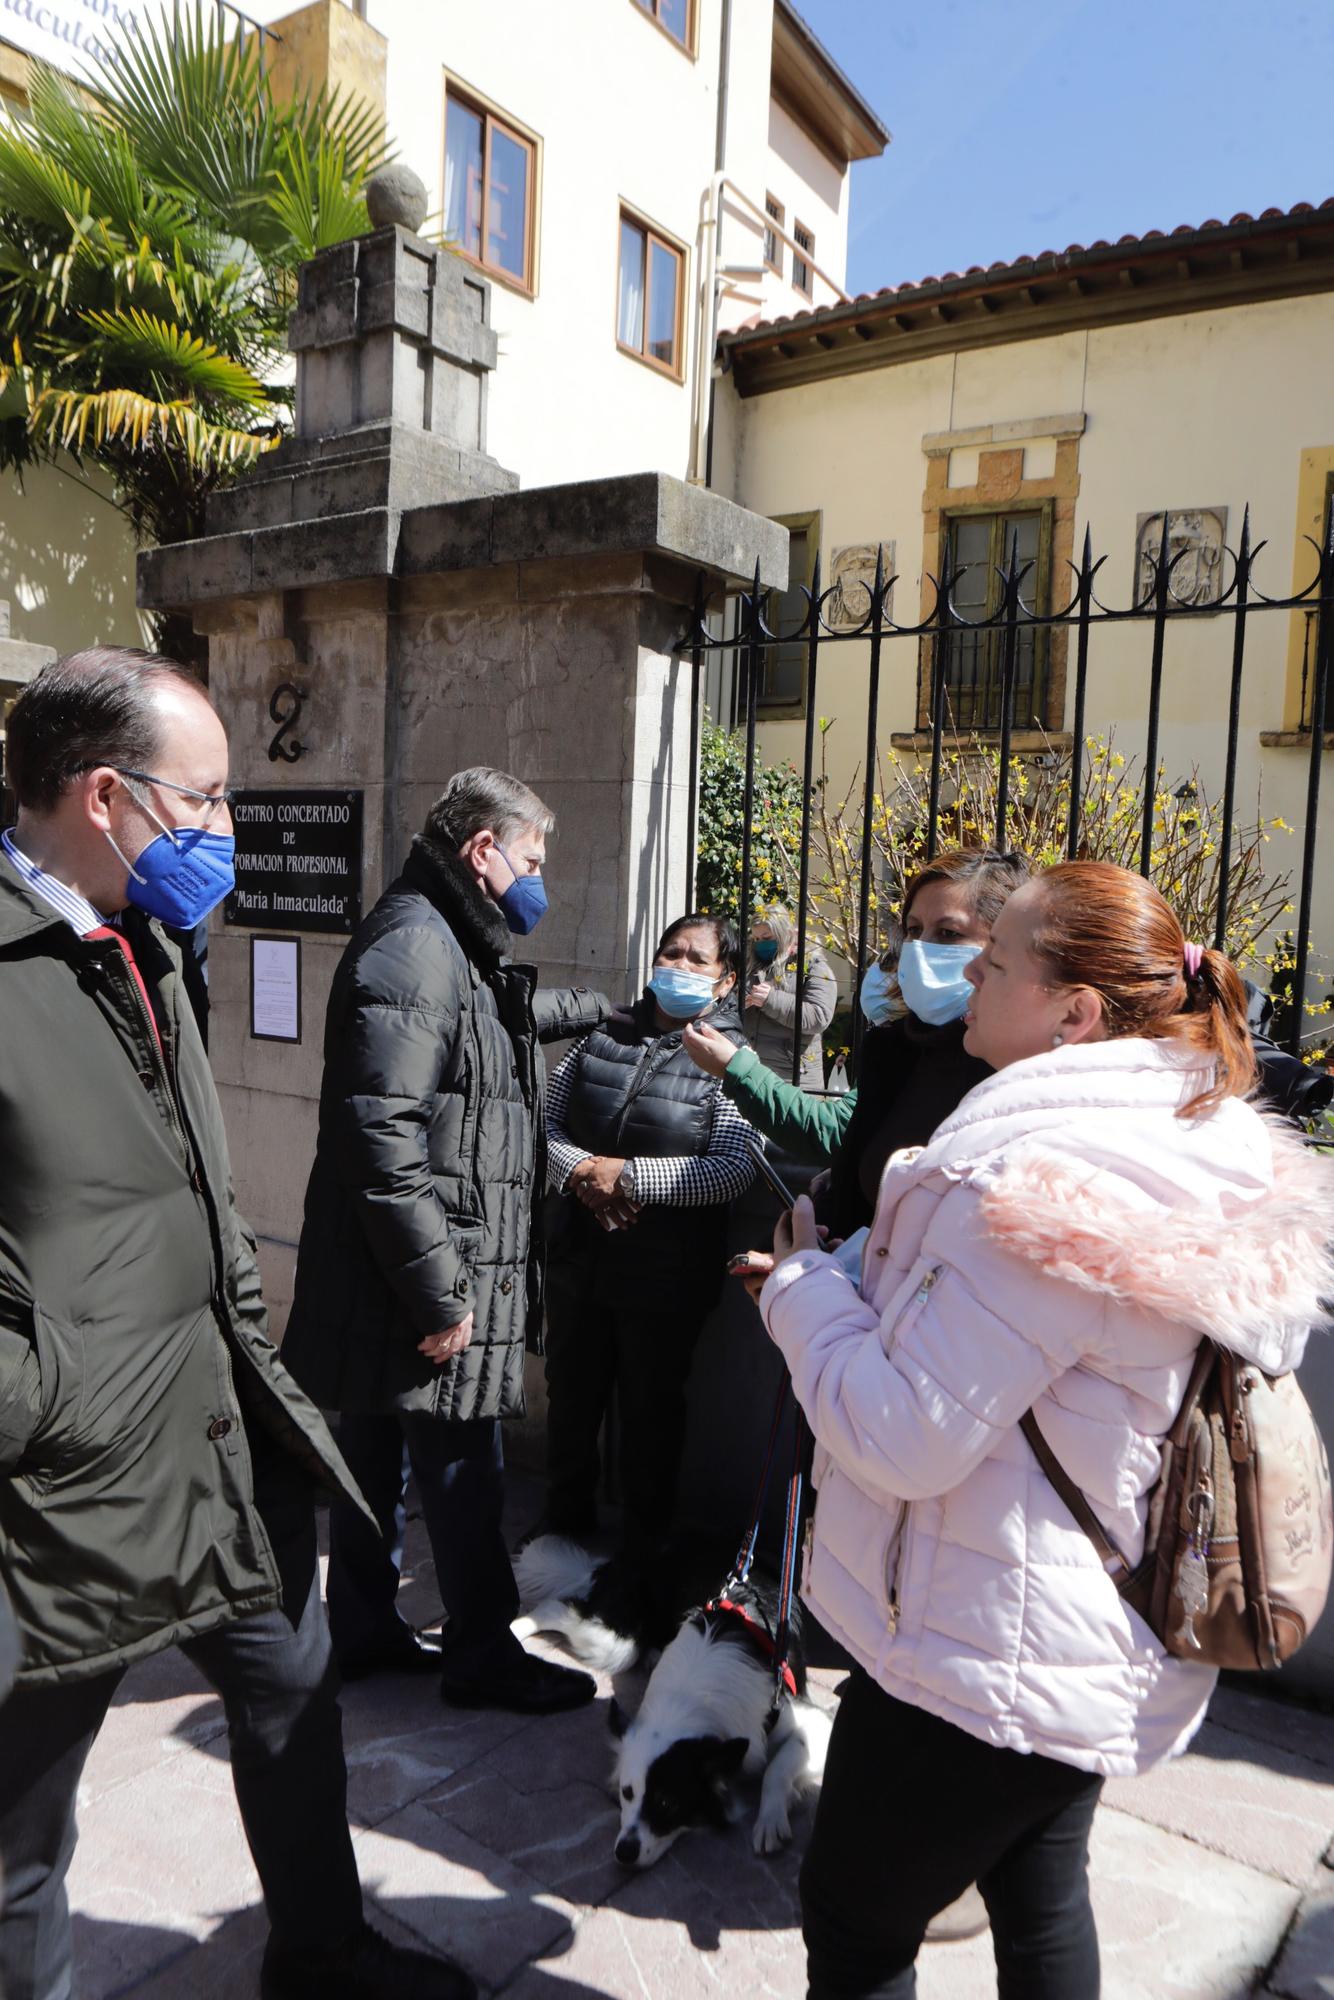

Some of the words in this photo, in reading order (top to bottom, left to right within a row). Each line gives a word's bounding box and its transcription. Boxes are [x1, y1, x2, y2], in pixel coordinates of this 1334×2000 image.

[267, 683, 304, 764] 2
[234, 804, 274, 822] CENTRO
[277, 805, 350, 823] CONCERTADO
[282, 831, 296, 844] DE
[234, 853, 283, 872] FORMACION
[286, 855, 348, 875] PROFESIONAL
[273, 892, 348, 914] Inmaculada"
